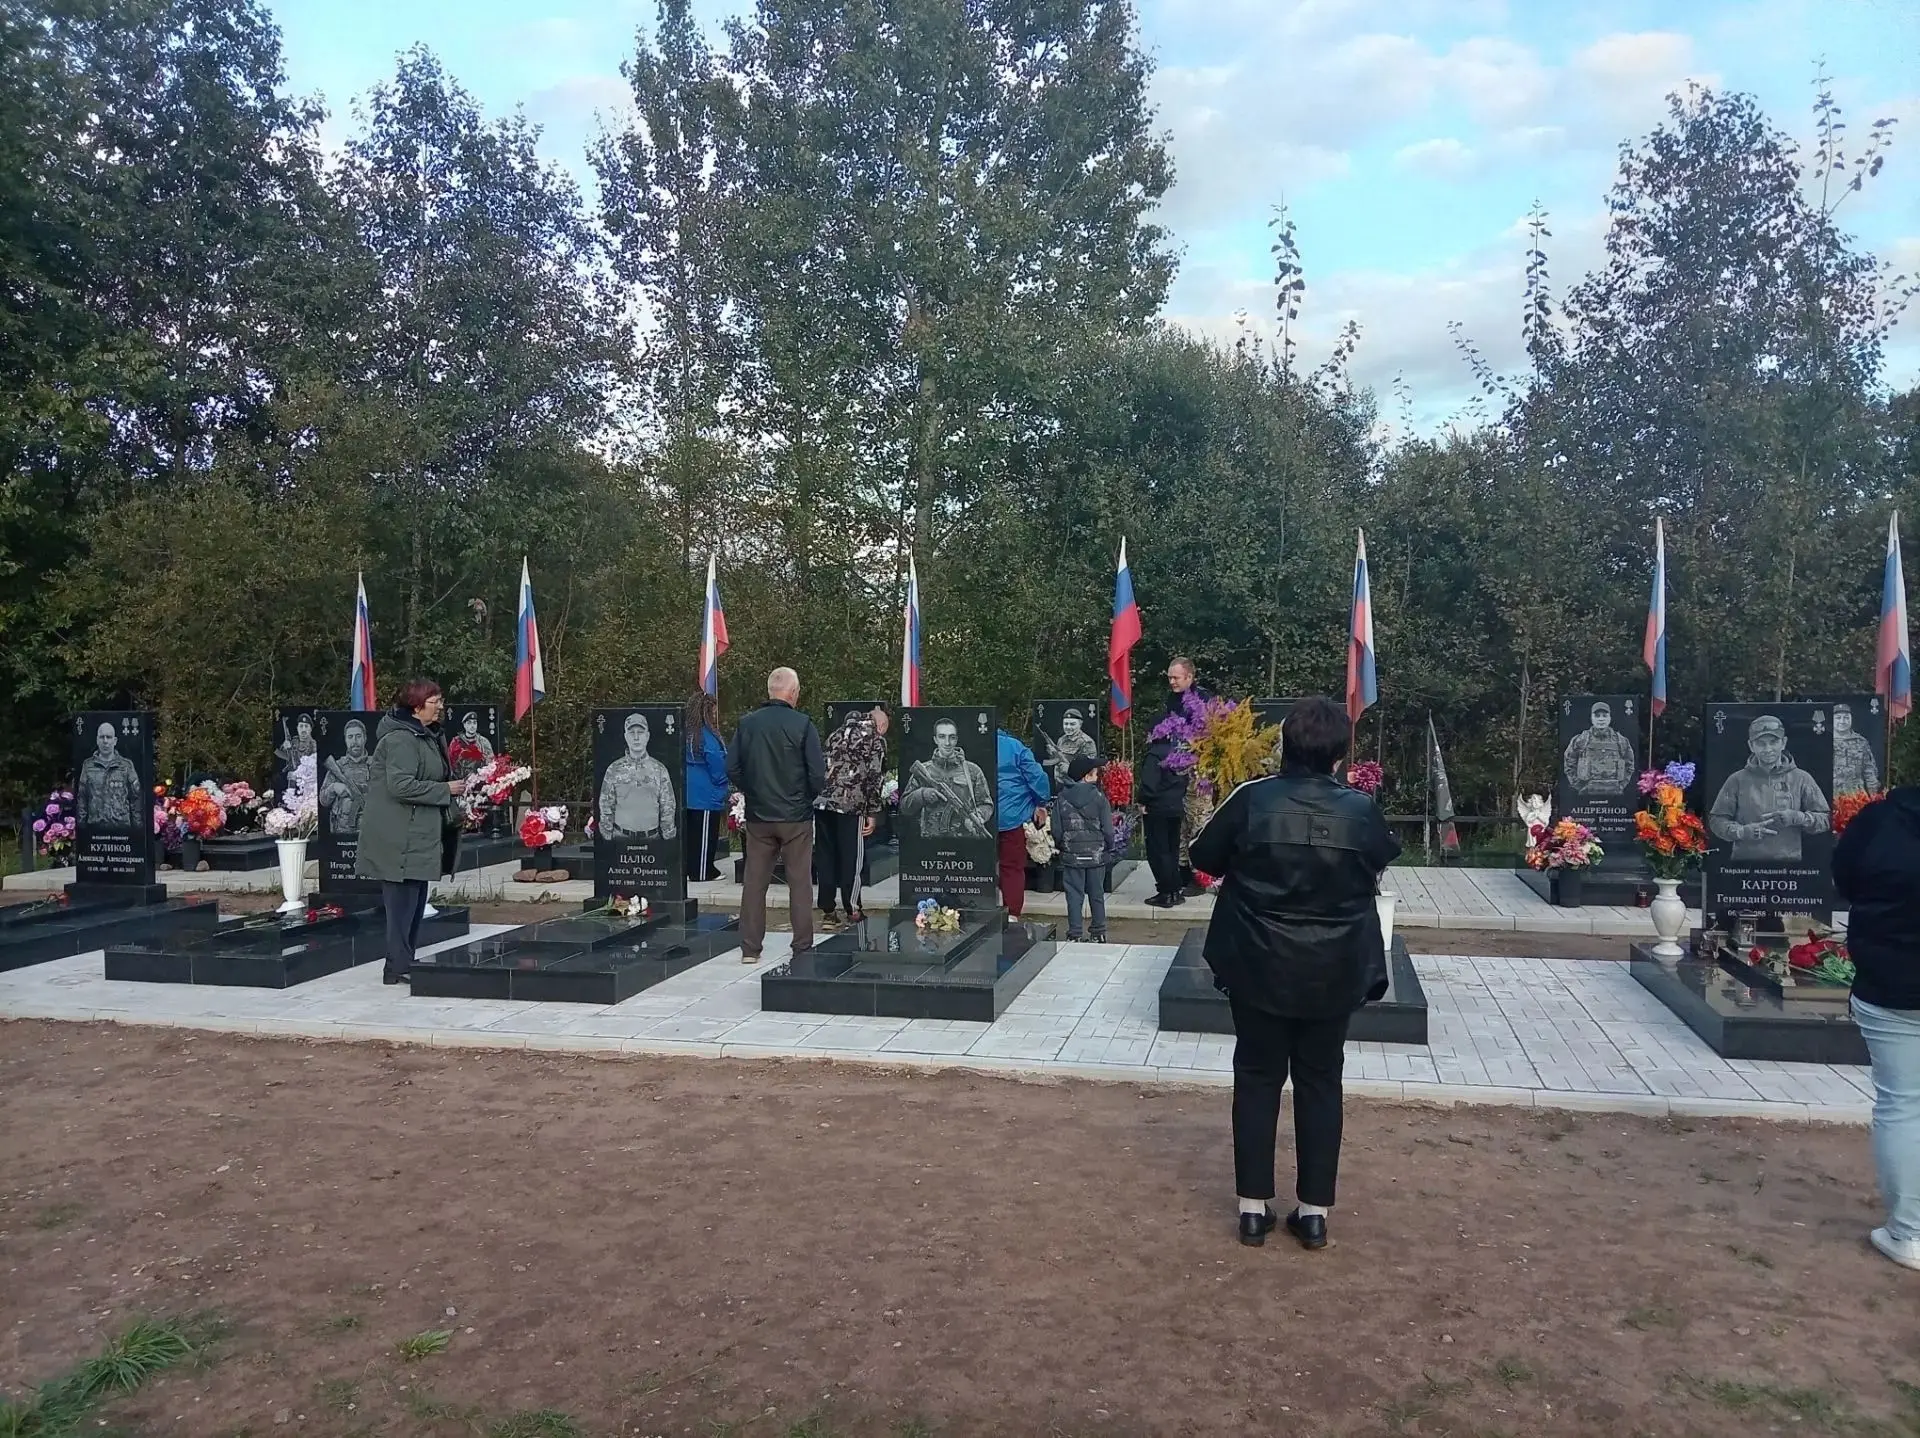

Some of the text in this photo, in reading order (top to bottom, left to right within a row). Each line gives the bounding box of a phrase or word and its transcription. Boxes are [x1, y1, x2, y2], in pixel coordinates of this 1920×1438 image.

[1570, 806, 1627, 815] АНДРЕЯНОВ
[90, 843, 131, 853] КУЛИКОВ
[78, 854, 145, 864] Александр Александрович
[620, 855, 656, 864] ЦАЛКО
[330, 861, 351, 870] Игорь
[921, 860, 974, 870] ЧУБАРОВ
[608, 866, 668, 876] Алесь Юрьевич
[902, 873, 993, 883] Владимир Анатольевич
[1741, 880, 1798, 890] КАРГОВ
[1716, 893, 1823, 905] Геннадий Олегович
